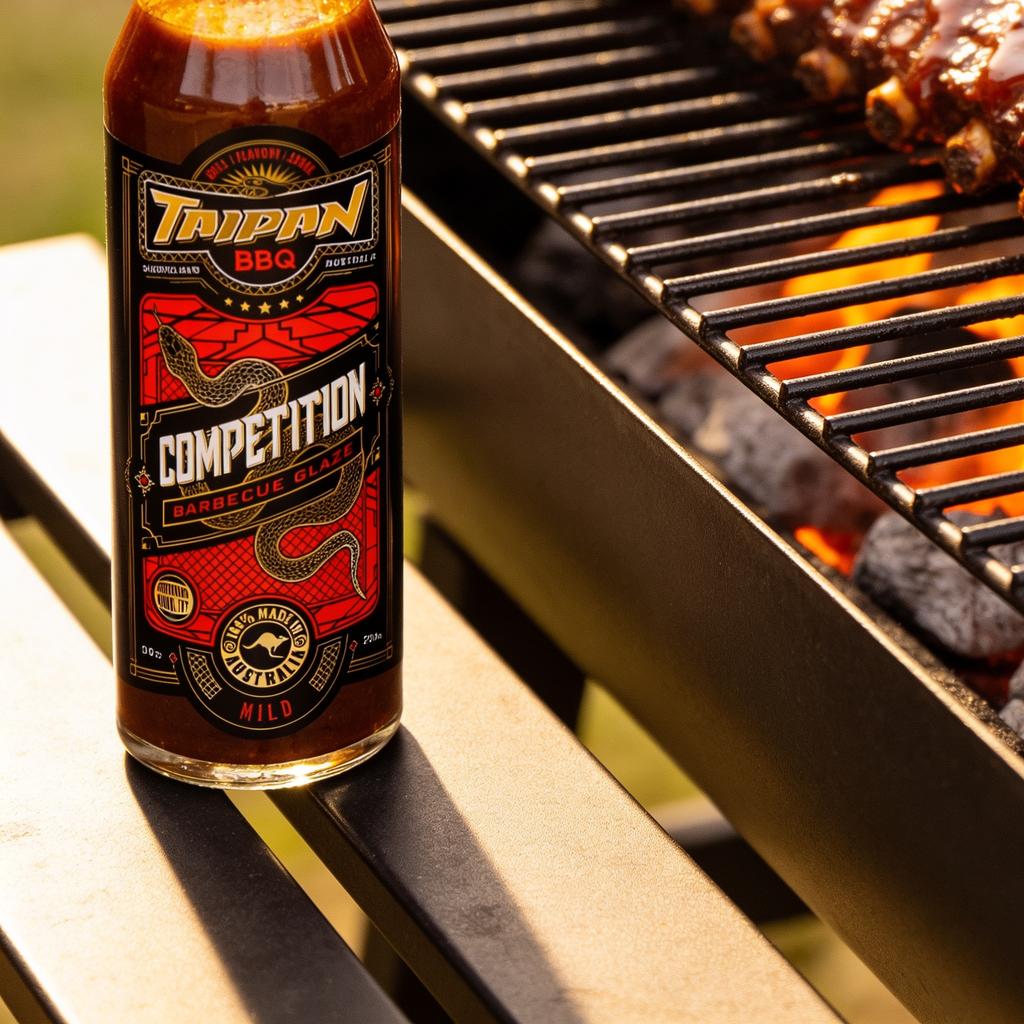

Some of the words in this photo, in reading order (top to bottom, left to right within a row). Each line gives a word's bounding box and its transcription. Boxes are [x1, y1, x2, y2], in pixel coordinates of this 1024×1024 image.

[150, 178, 369, 246] TAIPAN
[234, 249, 296, 272] BBQ
[159, 362, 367, 488] COMPETITION
[172, 478, 285, 518] BARBECUE
[294, 443, 354, 484] GLAZE
[257, 607, 295, 625] MADE
[240, 699, 293, 722] MILD
